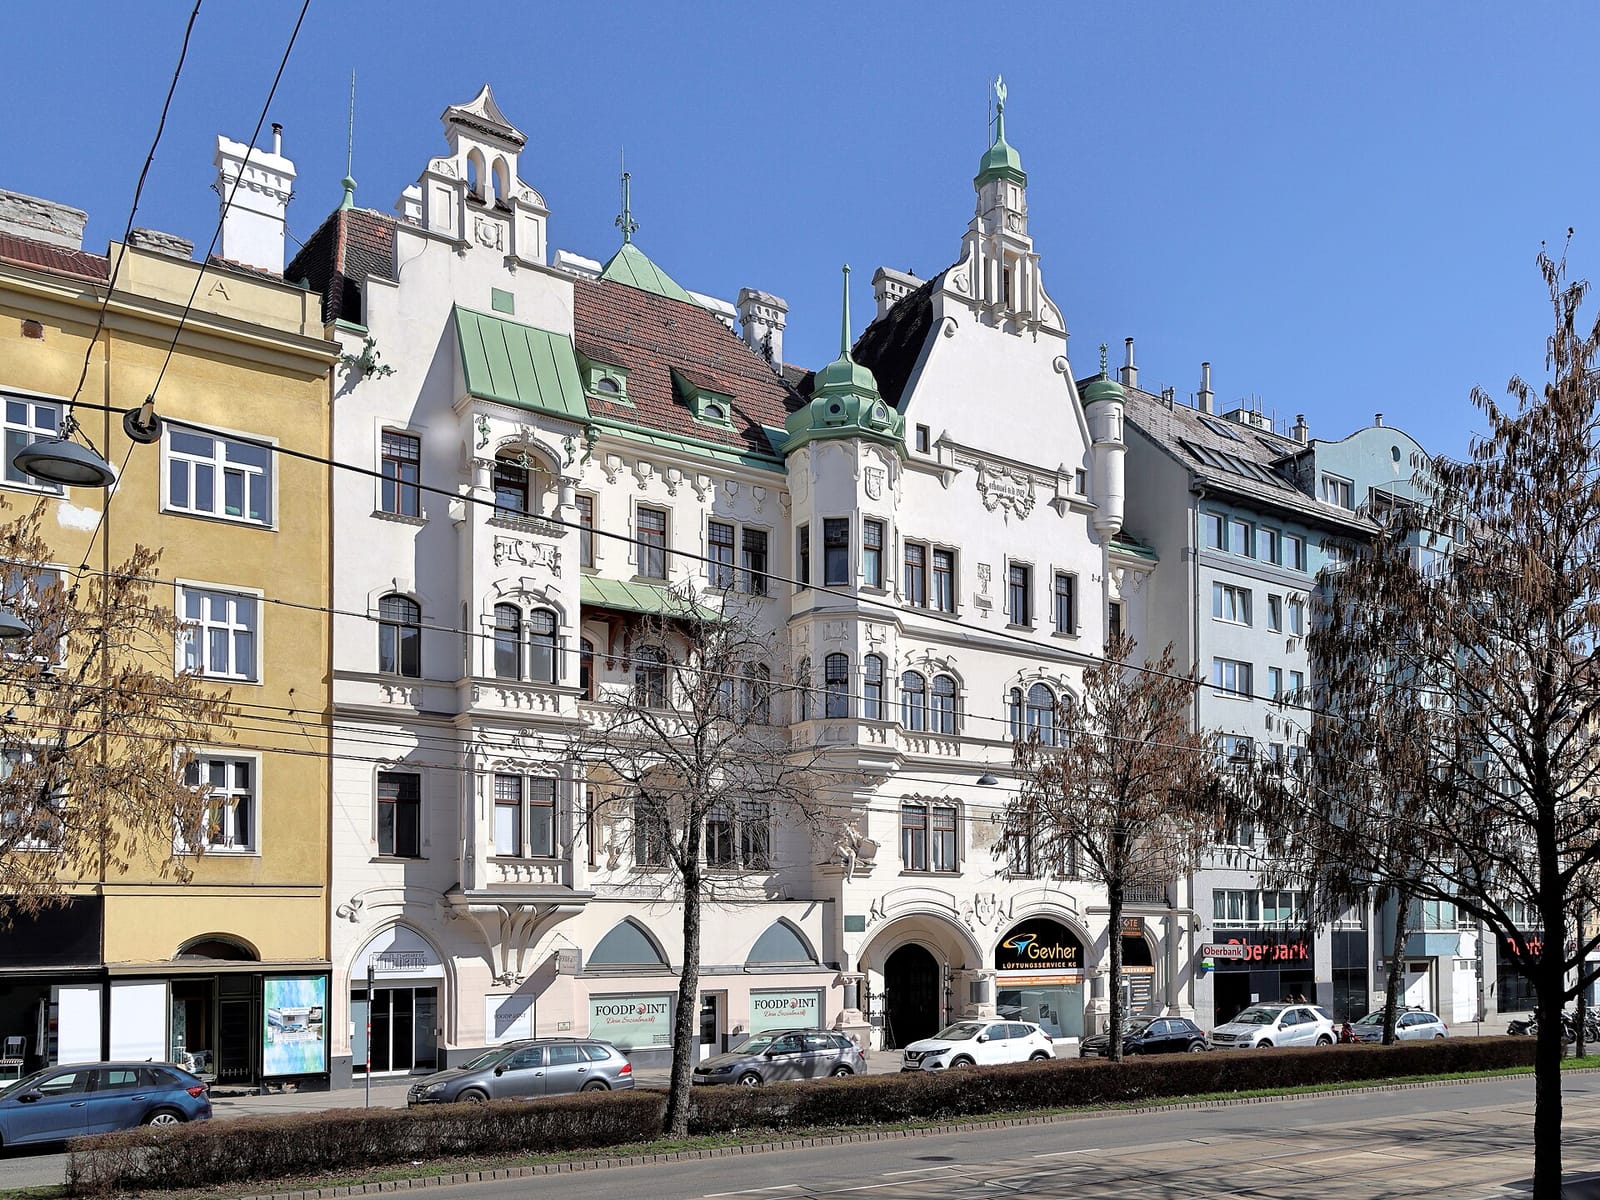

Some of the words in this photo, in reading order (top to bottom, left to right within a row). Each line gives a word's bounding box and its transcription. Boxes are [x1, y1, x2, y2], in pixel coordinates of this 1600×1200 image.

[1027, 942, 1077, 959] Gevher
[1203, 946, 1242, 956] Oberbank
[1002, 961, 1066, 969] LÜFTUNGSSERVICE
[595, 1002, 667, 1016] FOODPOINT
[754, 997, 817, 1010] FOODPOINT
